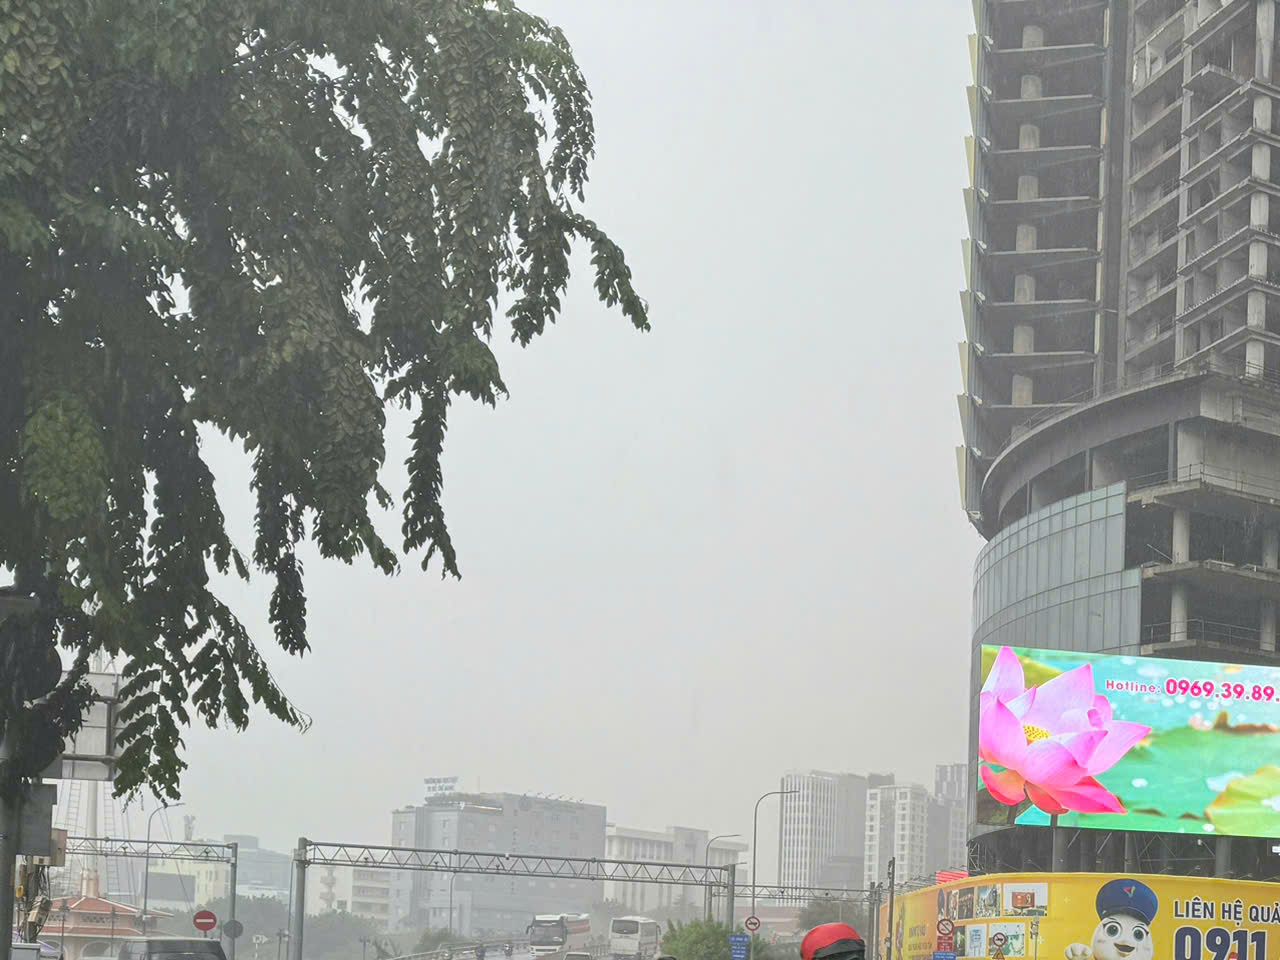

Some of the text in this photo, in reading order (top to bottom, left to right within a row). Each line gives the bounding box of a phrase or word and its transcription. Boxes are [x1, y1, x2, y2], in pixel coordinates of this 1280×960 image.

[1106, 680, 1160, 694] Hotline:
[1174, 896, 1215, 919] LIÊN
[1221, 899, 1243, 926] HỆ
